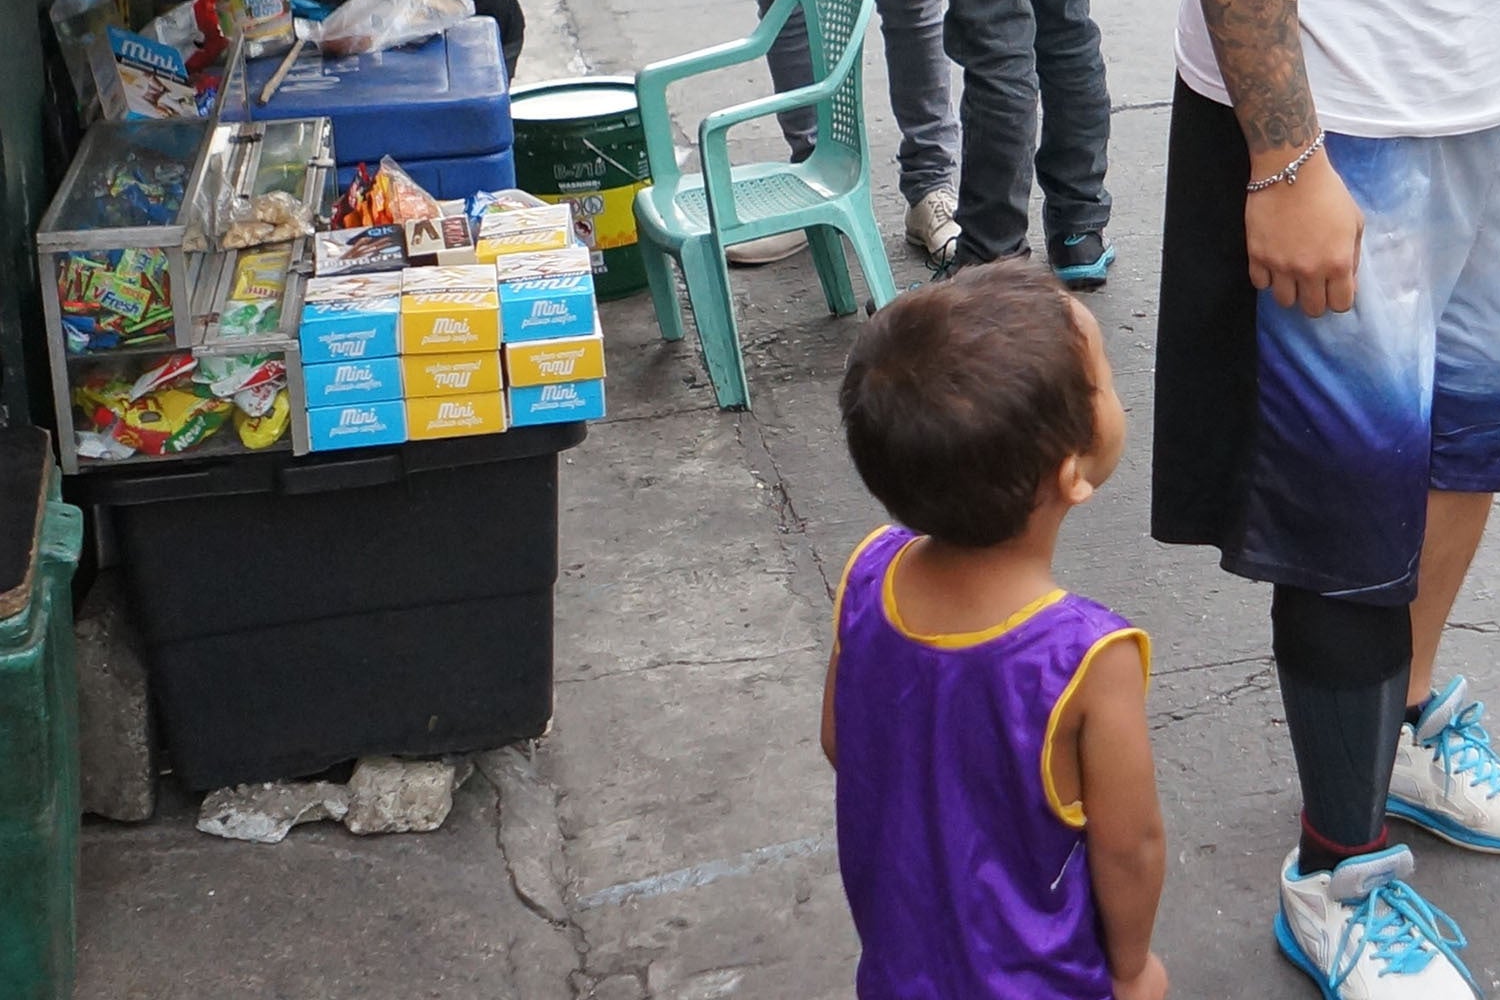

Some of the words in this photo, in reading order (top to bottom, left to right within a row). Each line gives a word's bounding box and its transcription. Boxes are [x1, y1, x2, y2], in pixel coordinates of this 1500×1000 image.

[101, 291, 140, 314] Fresh
[531, 299, 568, 316] Mini
[432, 318, 469, 334] Mini
[327, 340, 366, 357] Mini
[335, 365, 372, 383] Mini
[539, 359, 576, 376] Mini
[435, 373, 471, 389] Mini
[541, 384, 577, 400] Mini
[340, 408, 377, 426] Mini
[437, 402, 474, 418] Mini
